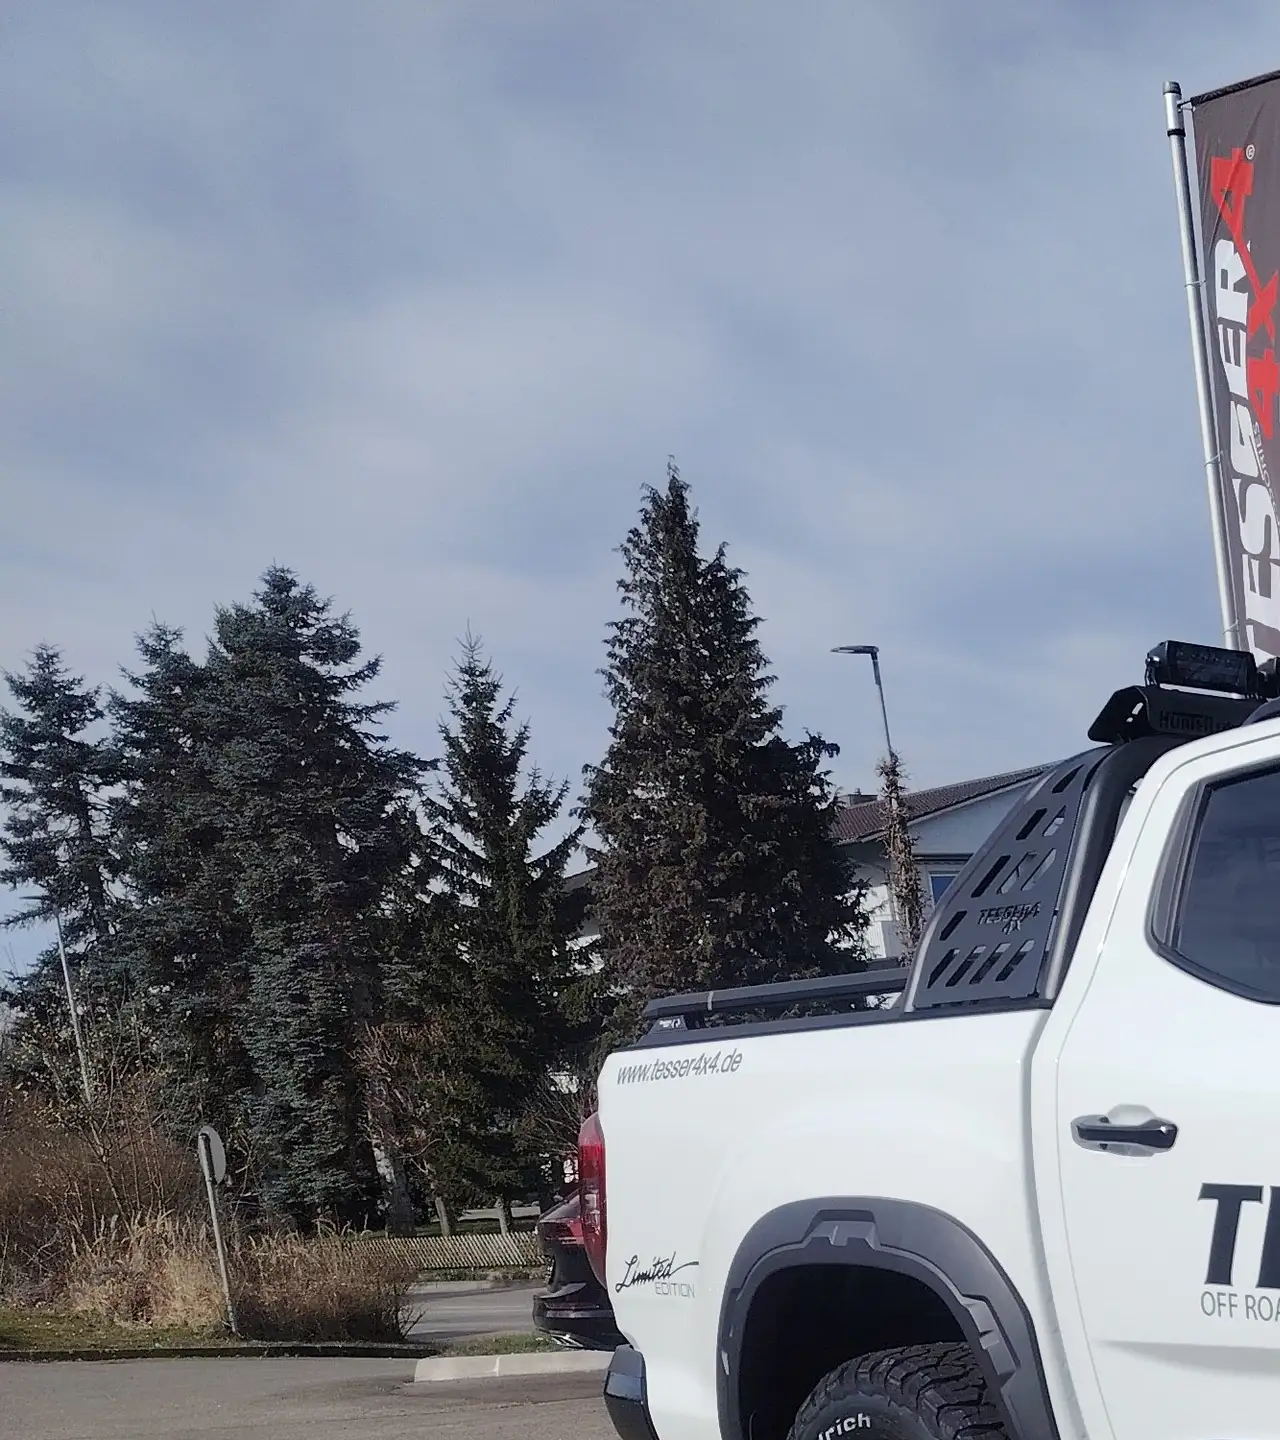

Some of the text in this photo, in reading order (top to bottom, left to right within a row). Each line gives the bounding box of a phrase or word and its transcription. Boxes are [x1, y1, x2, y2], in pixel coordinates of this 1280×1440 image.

[616, 1047, 743, 1085] www.tesser4x4.de
[615, 1251, 699, 1293] Limited
[654, 1282, 696, 1298] EDITION
[1200, 1290, 1240, 1318] OFF
